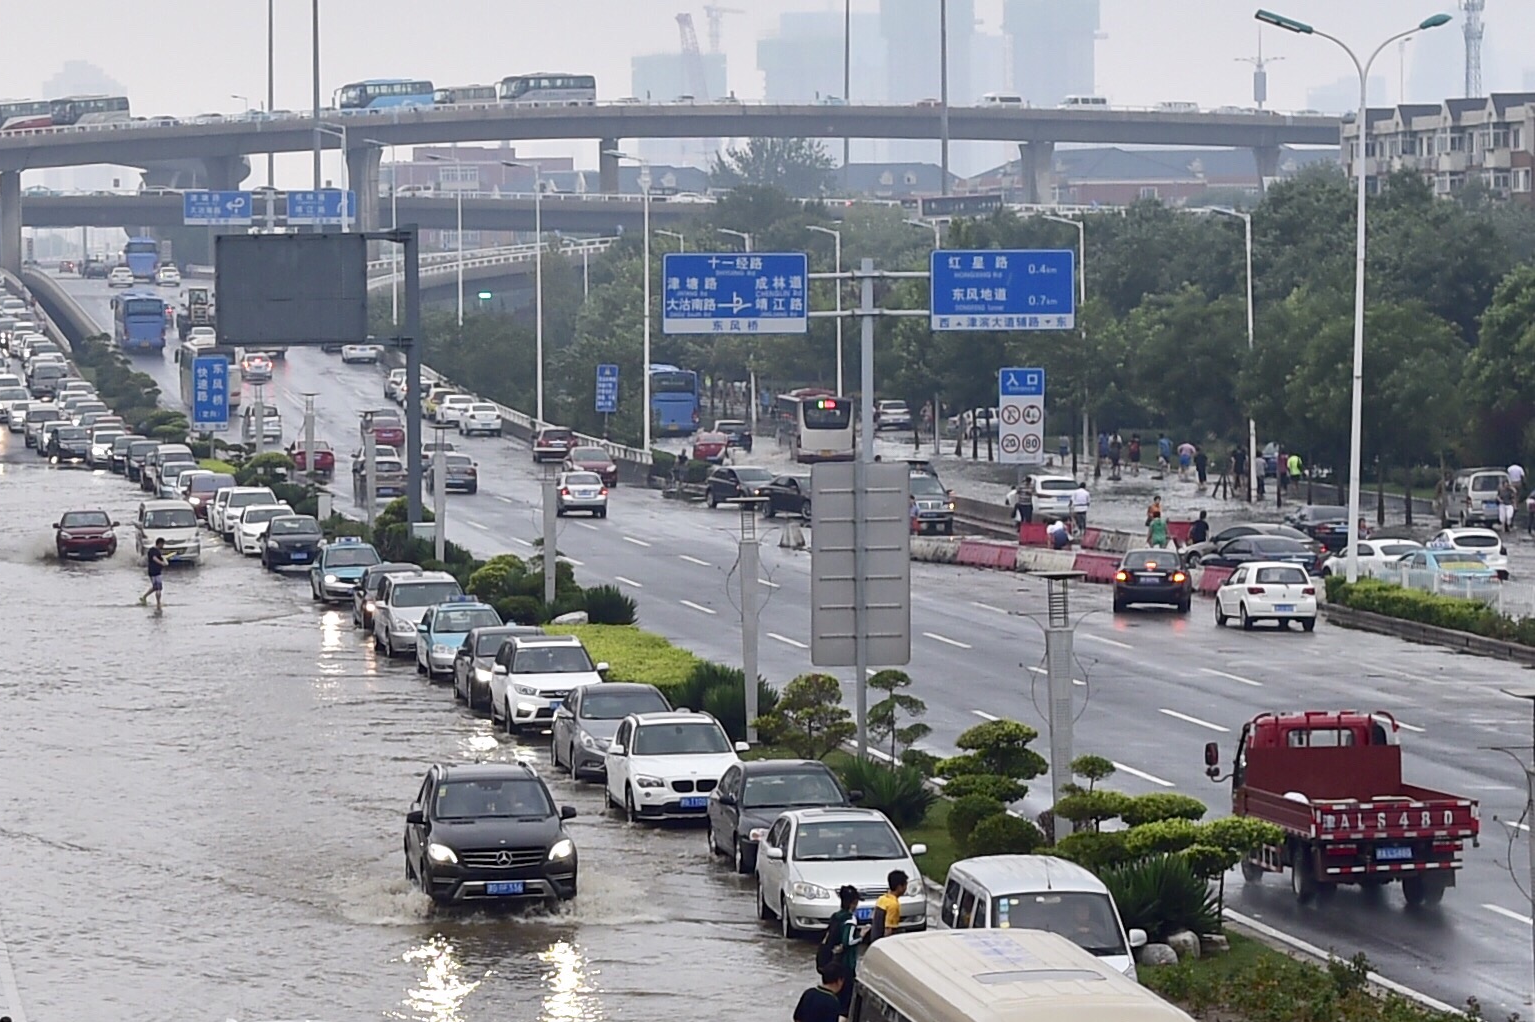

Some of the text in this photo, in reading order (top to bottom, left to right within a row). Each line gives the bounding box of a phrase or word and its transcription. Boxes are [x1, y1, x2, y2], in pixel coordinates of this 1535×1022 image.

[708, 256, 763, 270] 十一经路
[948, 256, 1008, 270] 红星路
[668, 277, 718, 291] 津塘路
[755, 275, 803, 290] 成林道
[952, 287, 1007, 301] 东风地道
[666, 298, 717, 312] 大沽南路
[755, 298, 803, 311] 靖江路
[712, 320, 759, 332] 东风桥
[1006, 372, 1038, 386] 入口
[1025, 438, 1038, 449] 80
